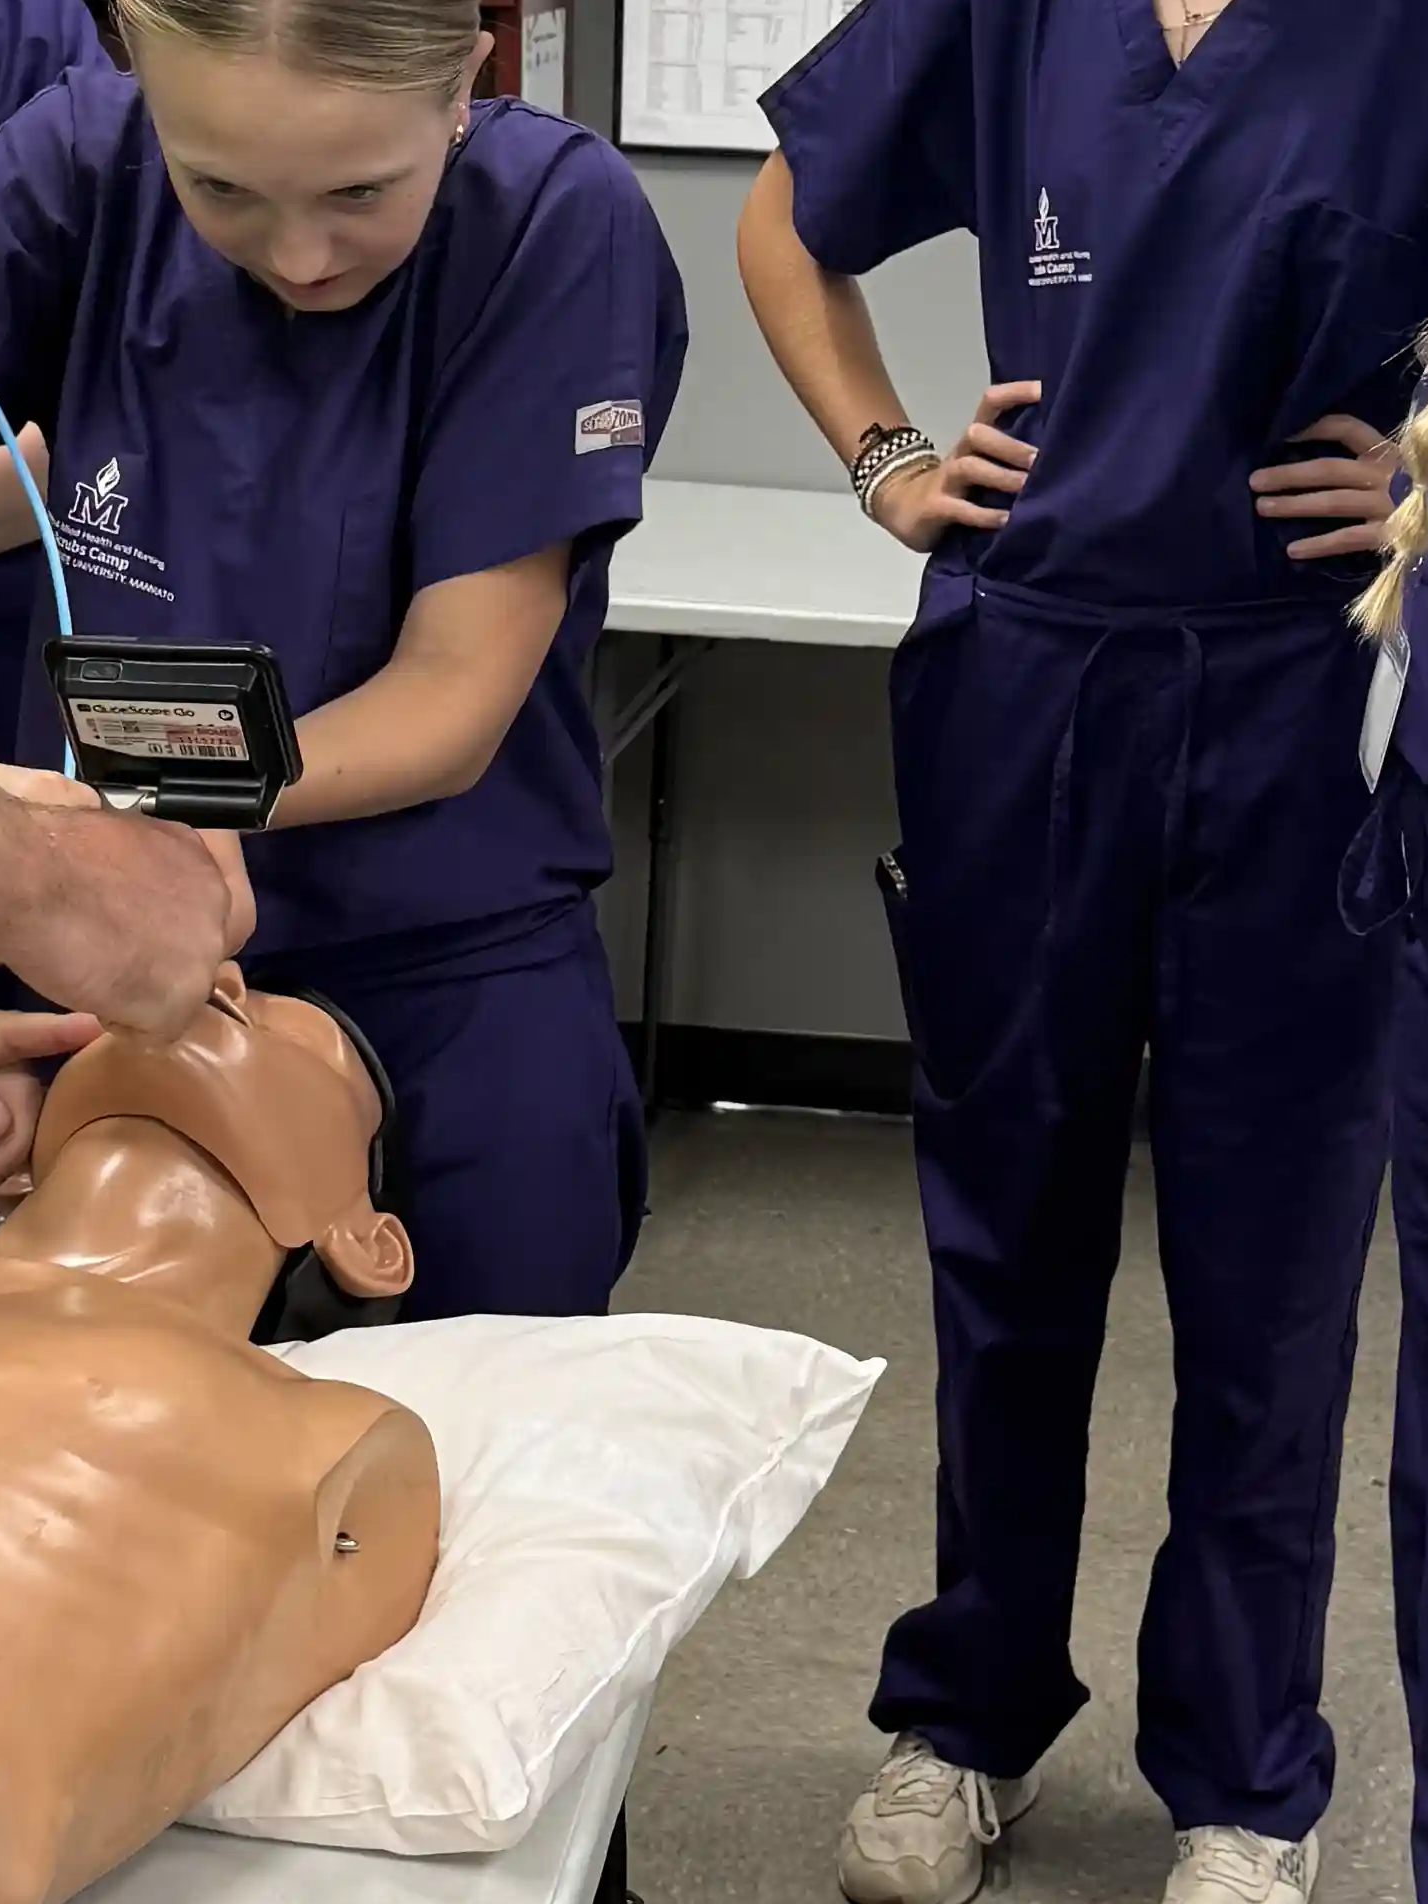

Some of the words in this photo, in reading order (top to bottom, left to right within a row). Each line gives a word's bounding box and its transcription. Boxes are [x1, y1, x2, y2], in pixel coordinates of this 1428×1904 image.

[1034, 216, 1060, 252] M
[68, 482, 129, 535] M
[88, 547, 131, 572] Camp
[113, 542, 133, 557] and
[173, 708, 196, 718] Go
